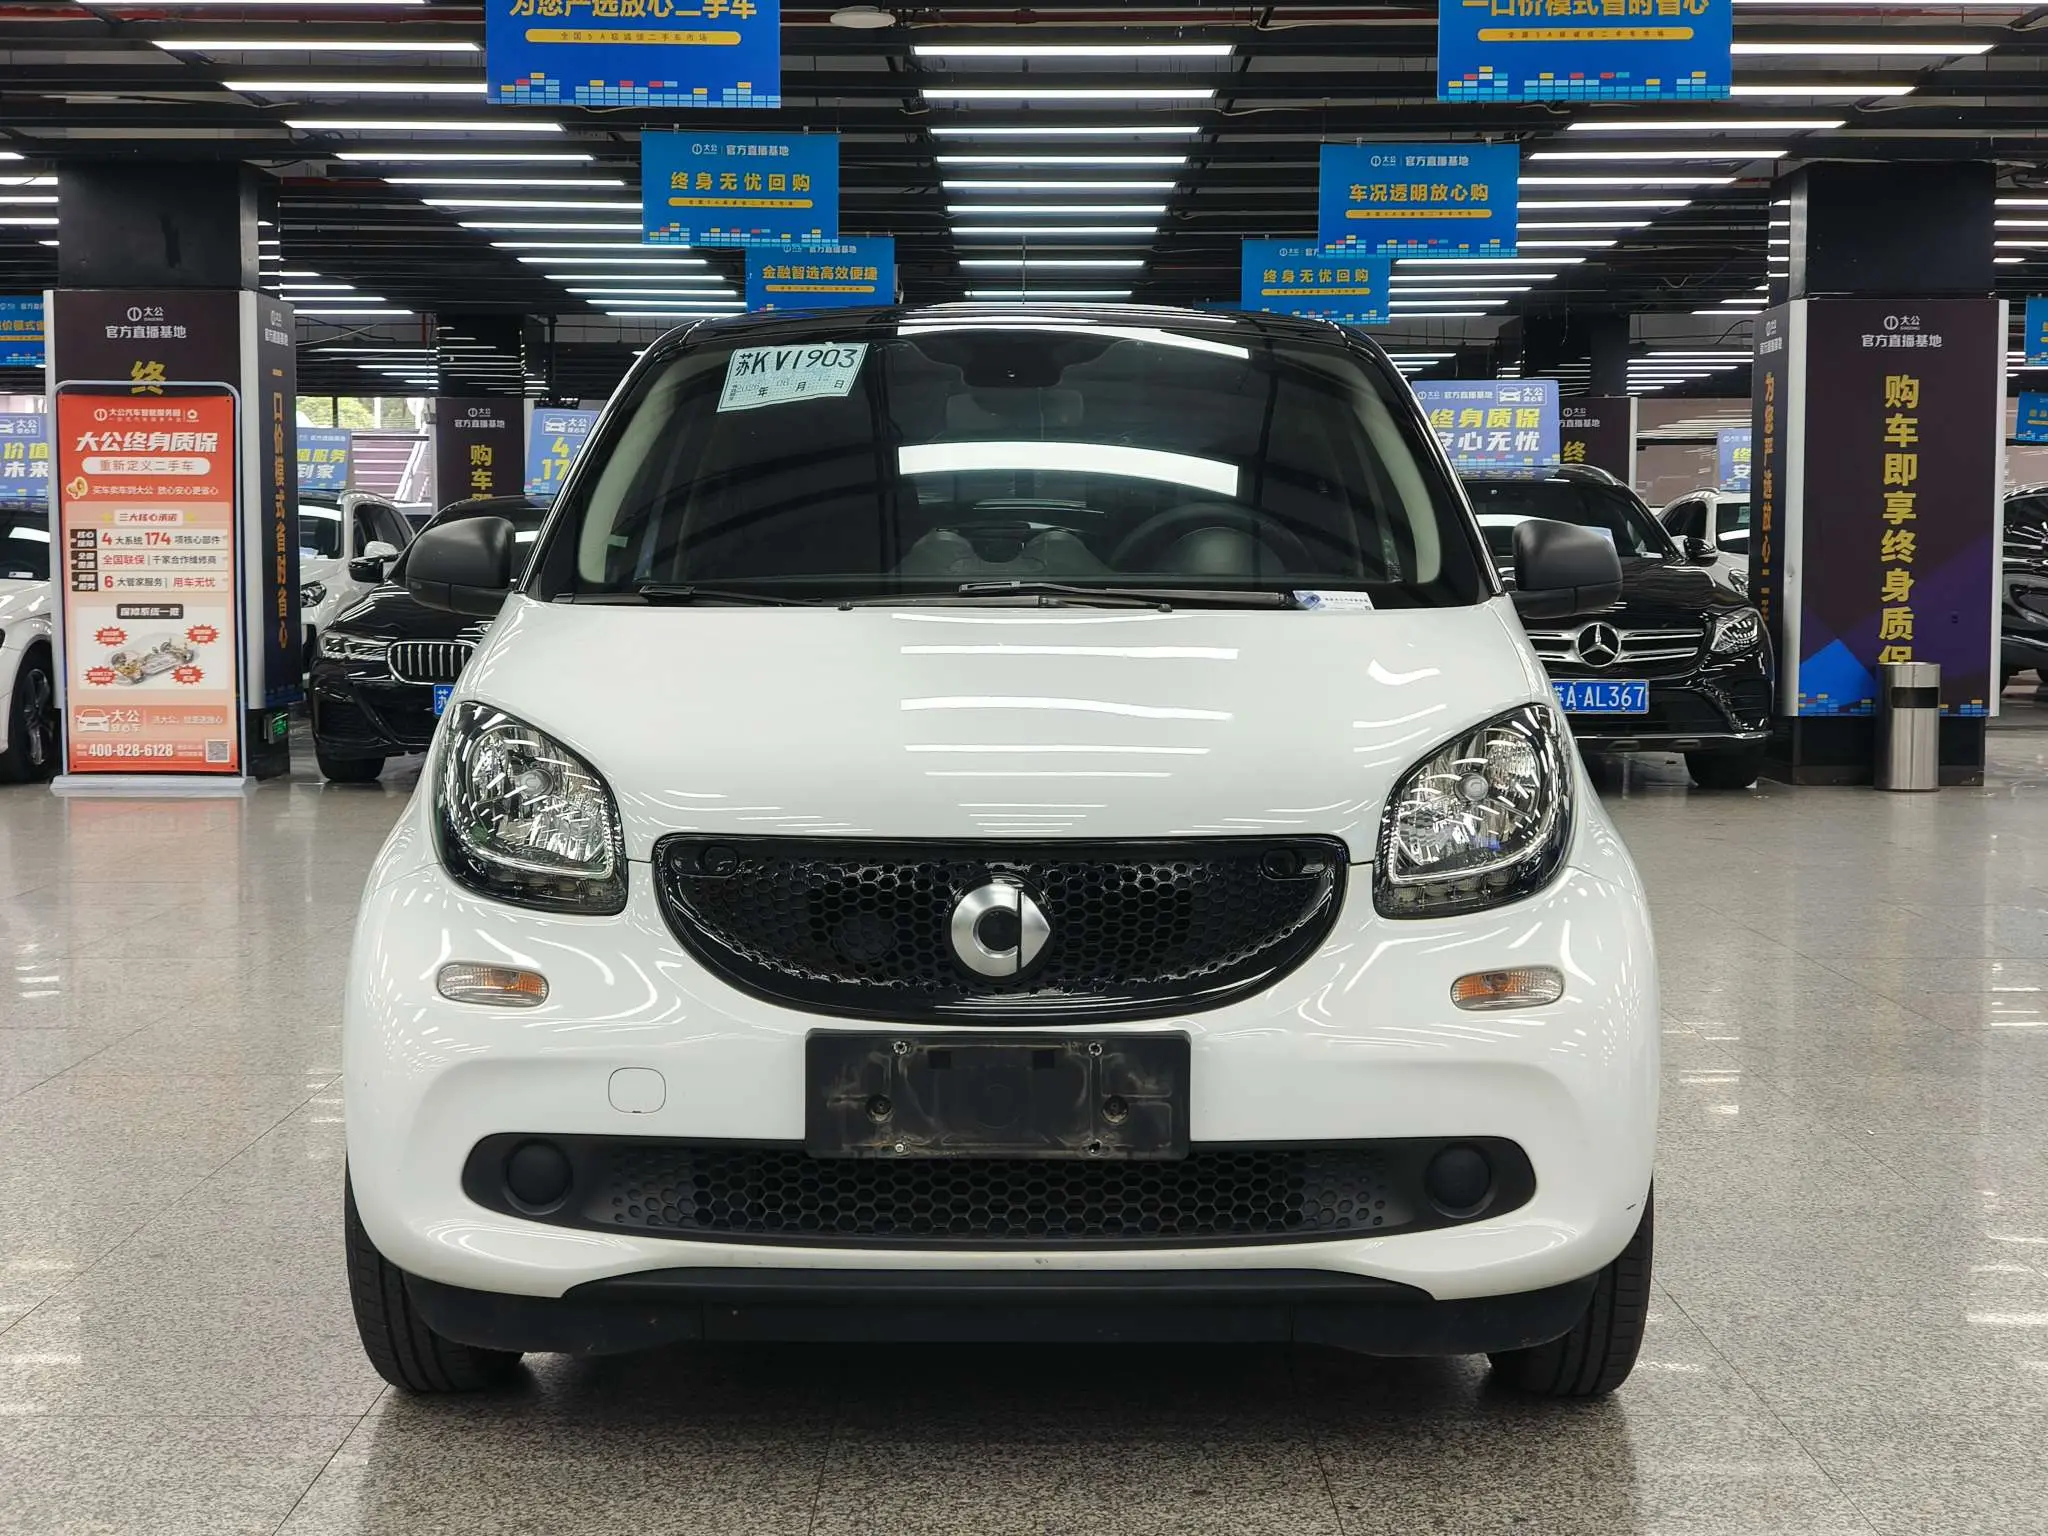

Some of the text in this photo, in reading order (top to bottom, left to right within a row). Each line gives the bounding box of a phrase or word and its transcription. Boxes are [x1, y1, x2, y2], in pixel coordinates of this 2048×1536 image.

[726, 145, 790, 157] 官方直播基地
[1405, 155, 1469, 167] 官方直播基地
[671, 172, 811, 192] 终身无忧回购
[1349, 183, 1489, 202] 车况透明放心购
[763, 265, 878, 281] 金融智选高效便捷
[1263, 269, 1369, 283] 终身无忧回购
[143, 306, 164, 317] 大公
[1900, 315, 1920, 326] 大公
[105, 325, 187, 339] 官方直播基地
[1861, 334, 1943, 348] 官方直播基地
[735, 349, 859, 376] 苏KV1903
[130, 360, 167, 395] 终
[757, 386, 769, 397] 年
[795, 381, 807, 392] 月
[834, 379, 845, 389] 日
[1523, 387, 1543, 396] 大公
[17, 419, 38, 428] 大公
[454, 419, 505, 428] 官方直播基地
[568, 418, 587, 427] 大公
[1430, 407, 1540, 428] 终身质保
[75, 431, 219, 453] 大公终身质保
[552, 436, 569, 458] 4
[1563, 441, 1587, 462] 终
[100, 460, 195, 472] 重新定义二手车
[102, 532, 112, 545] 4
[145, 532, 171, 545] 174
[103, 555, 144, 565] 全国联保
[104, 576, 113, 588] 6
[173, 577, 216, 587] 用车无忧
[111, 709, 141, 722] 大公
[89, 743, 174, 757] 400-828-6128
